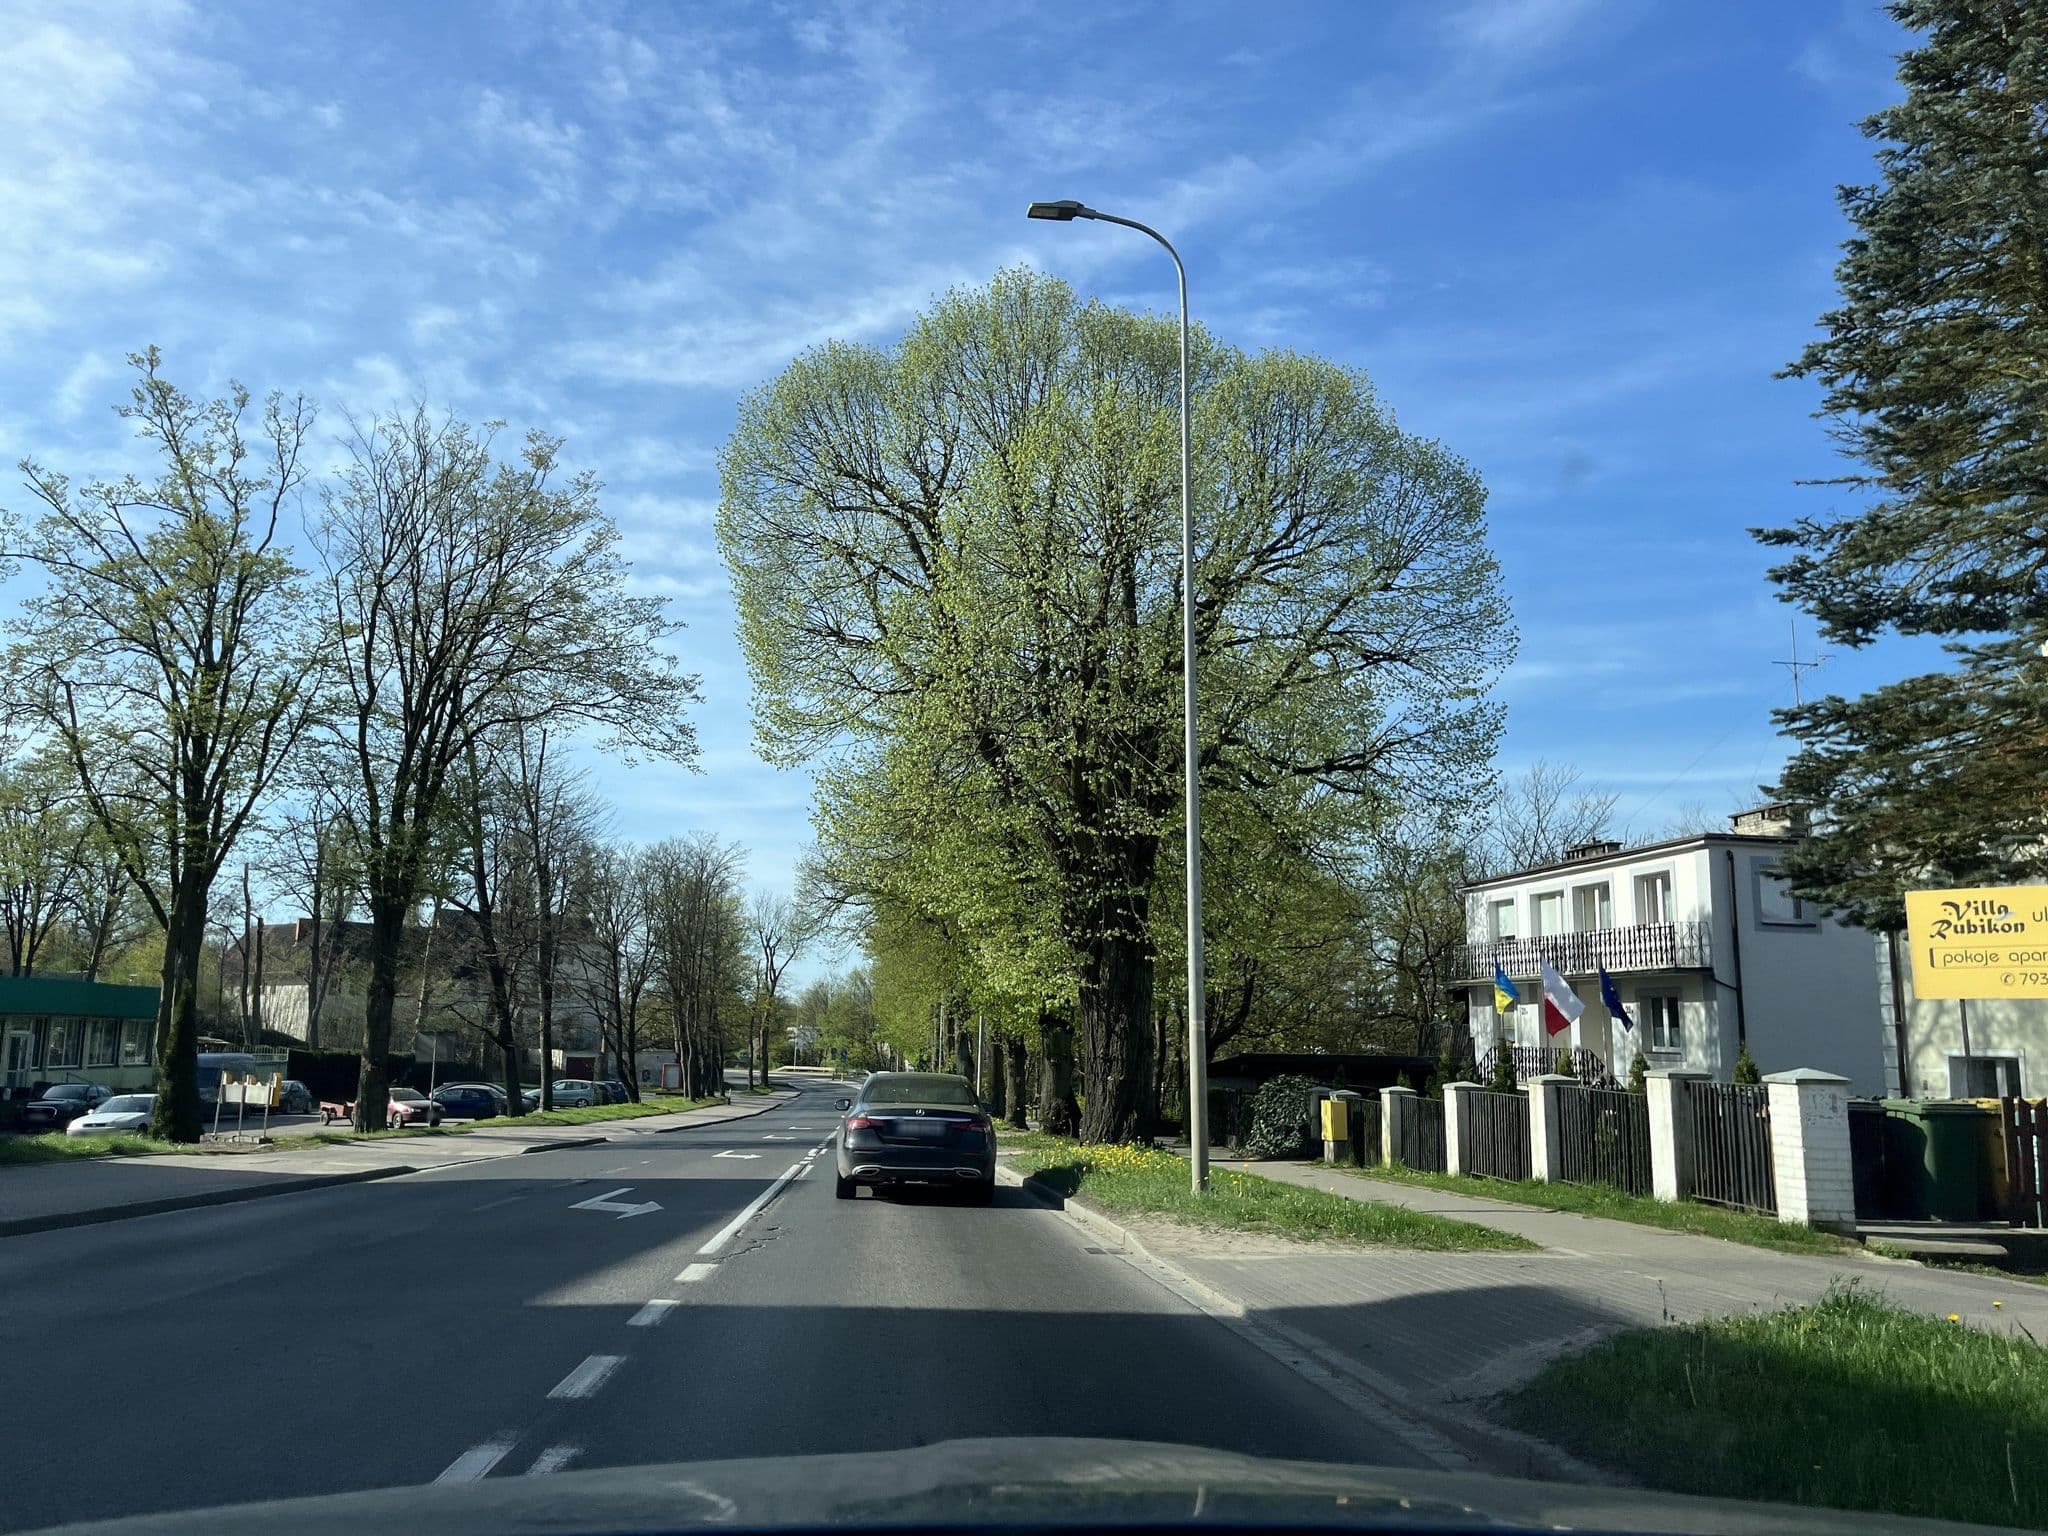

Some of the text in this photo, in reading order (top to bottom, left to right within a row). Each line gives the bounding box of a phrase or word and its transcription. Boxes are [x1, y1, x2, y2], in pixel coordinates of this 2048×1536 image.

[1941, 900, 2009, 920] Villa
[1929, 919, 2025, 940] Rubikon
[1943, 950, 2000, 966] pokoje
[2019, 972, 2048, 985] 793
